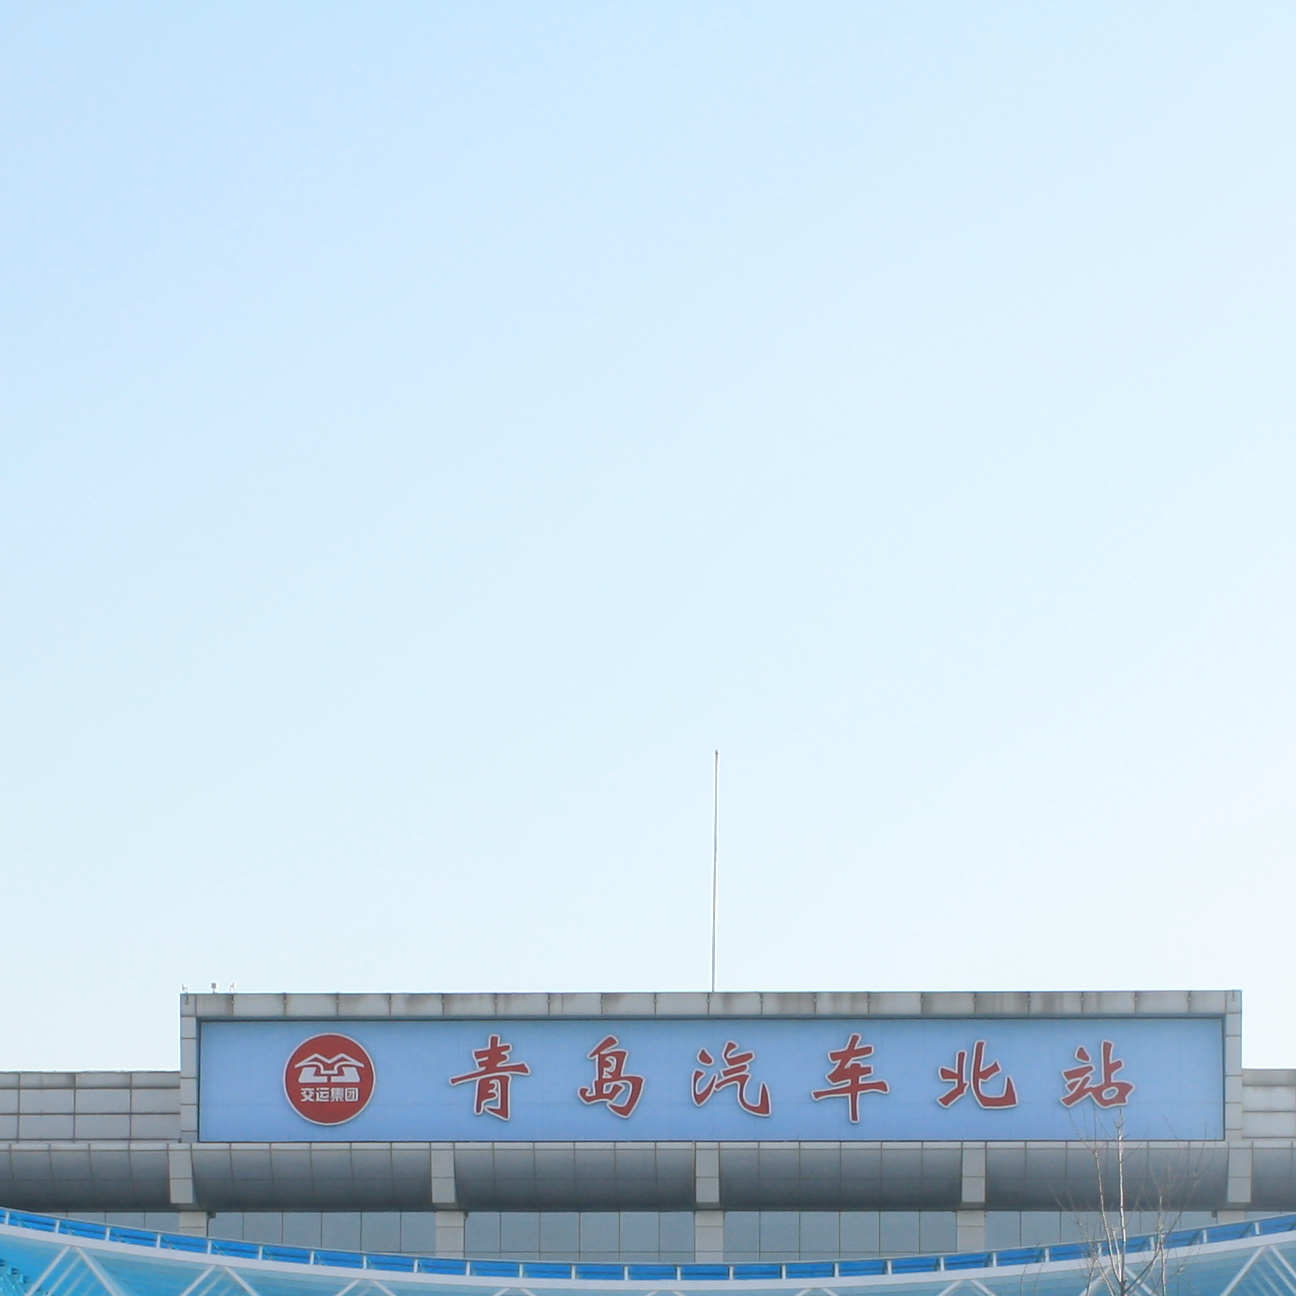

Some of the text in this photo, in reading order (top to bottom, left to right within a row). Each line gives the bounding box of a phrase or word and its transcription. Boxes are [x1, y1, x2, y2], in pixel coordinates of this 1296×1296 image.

[300, 1086, 359, 1103] 交运集团
[448, 1033, 1136, 1124] 青岛汽车北站
